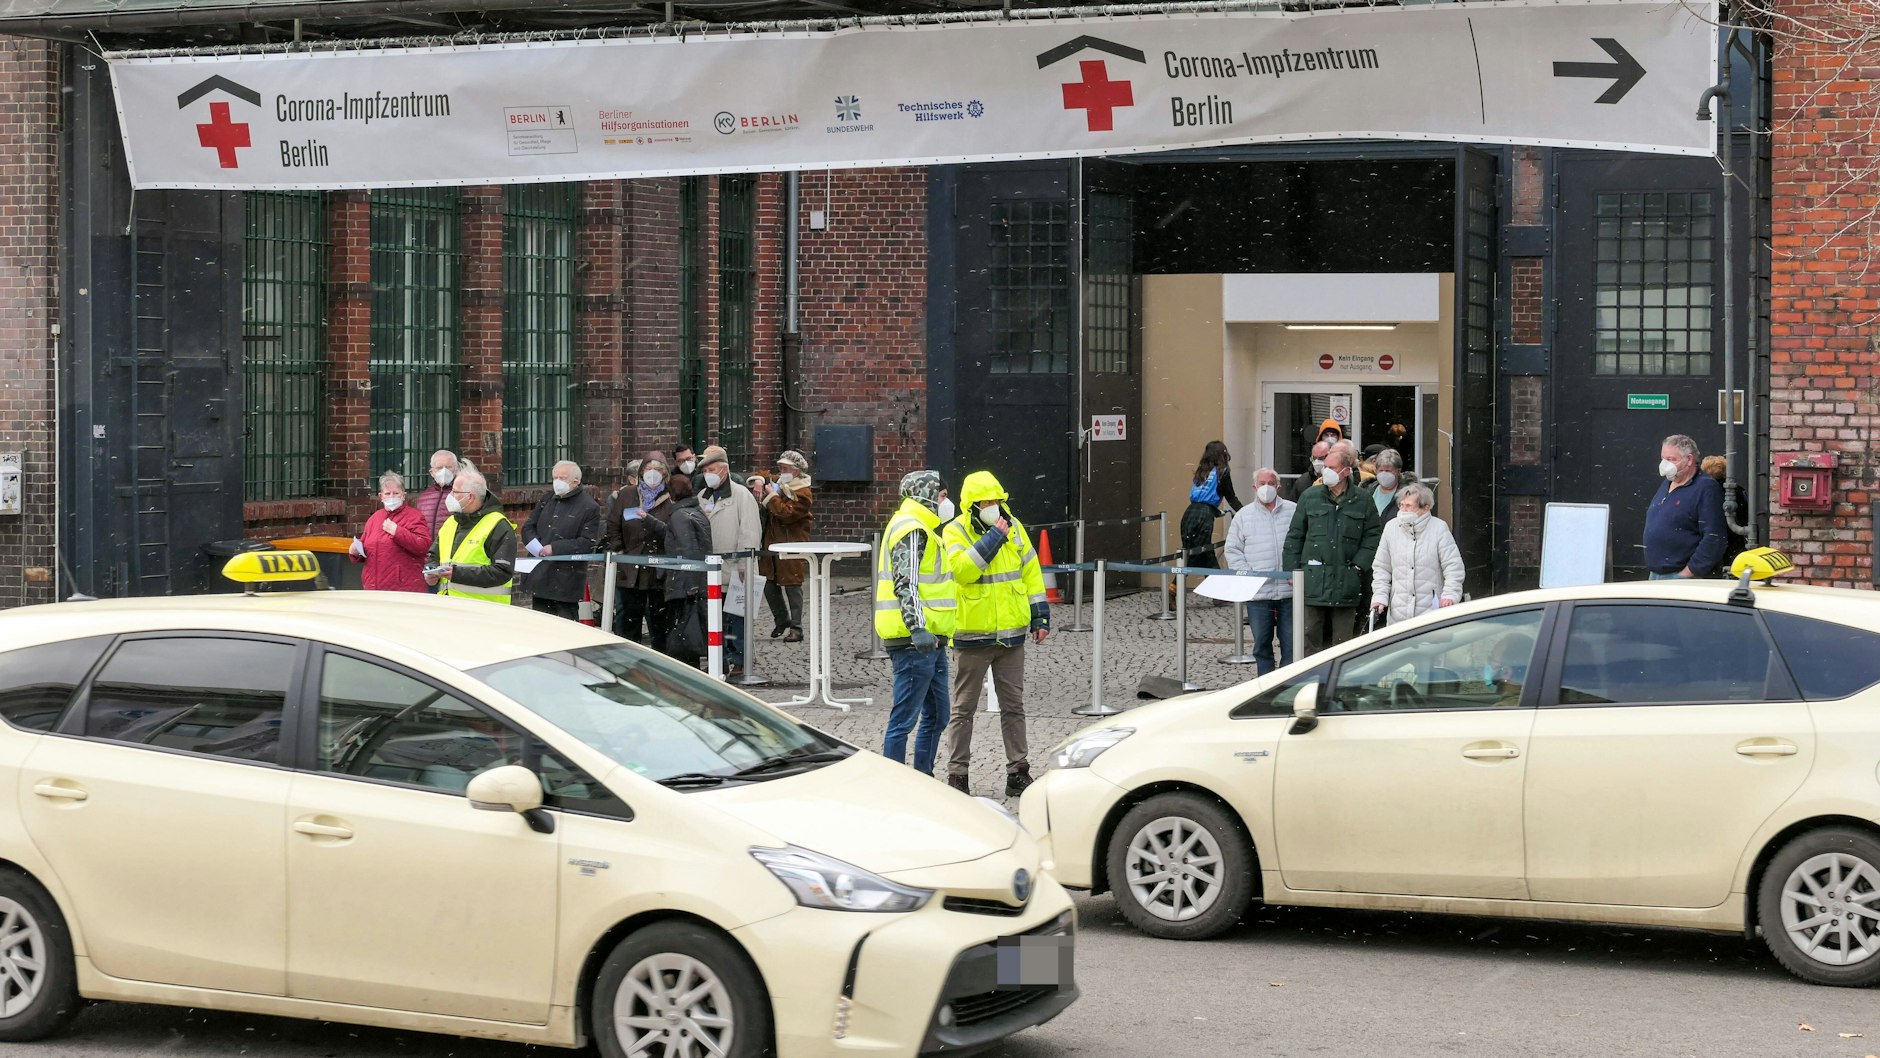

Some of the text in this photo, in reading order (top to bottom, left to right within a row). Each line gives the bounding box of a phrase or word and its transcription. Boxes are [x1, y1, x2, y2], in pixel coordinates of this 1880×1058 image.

[1164, 47, 1379, 79] Corona-Impfzentrum
[276, 91, 450, 124] Corona-Impfzentrum
[898, 101, 963, 112] Technisches
[1171, 95, 1233, 127] Berlin
[510, 113, 546, 124] BERLIN
[599, 110, 632, 119] Berliner
[915, 111, 964, 122] Hilfswerk
[601, 120, 689, 132] Hilfsorganisationen
[741, 114, 799, 127] BERLIN
[826, 124, 874, 134] BUNDESWEHR
[280, 139, 329, 167] Berlin
[1352, 355, 1374, 363] Eingang
[1630, 397, 1665, 405] Notausgang
[262, 555, 312, 572] TAXI
